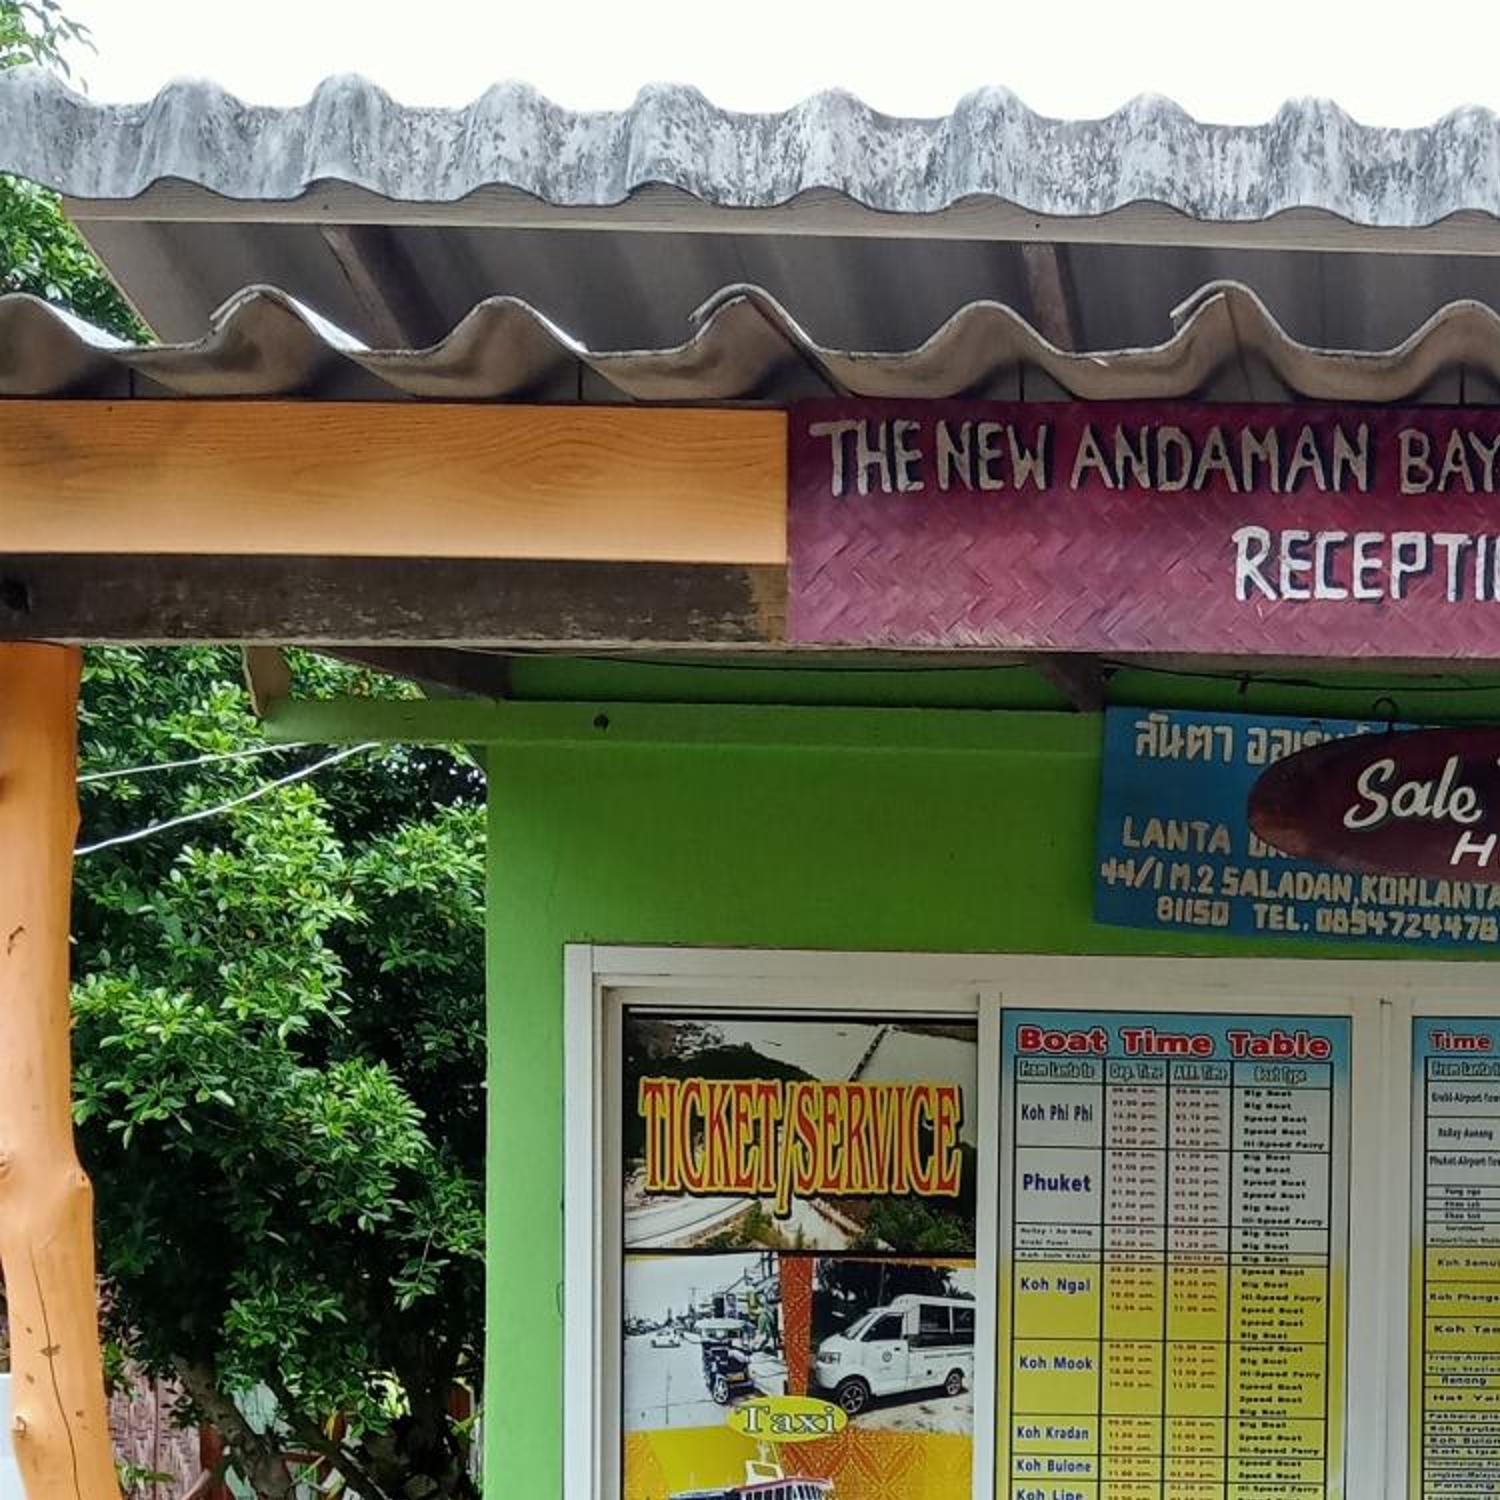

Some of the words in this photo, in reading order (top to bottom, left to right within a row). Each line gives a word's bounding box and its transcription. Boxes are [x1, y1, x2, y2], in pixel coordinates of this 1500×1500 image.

[814, 421, 923, 494] THE
[938, 424, 1049, 491] NEW
[1071, 427, 1369, 494] ANDAMAN
[1343, 757, 1482, 829] Sale
[1124, 818, 1230, 853] LANTA
[1017, 1027, 1108, 1054] Boat
[1120, 1028, 1213, 1055] Time
[1228, 1031, 1331, 1057] Table
[1430, 1032, 1492, 1052] Time
[1021, 1103, 1045, 1121] Koh
[1050, 1104, 1070, 1121] Phi
[1074, 1105, 1093, 1122] Phi
[1023, 1173, 1091, 1192] Phuket
[1021, 1277, 1051, 1292] Koh
[1057, 1278, 1091, 1294] Ngai
[1019, 1356, 1048, 1369] Koh
[1053, 1357, 1093, 1371] Mook
[736, 1405, 840, 1435] Taxi
[1017, 1426, 1041, 1440] Koh
[1045, 1426, 1089, 1440] Kradan
[1017, 1459, 1041, 1473] Koh
